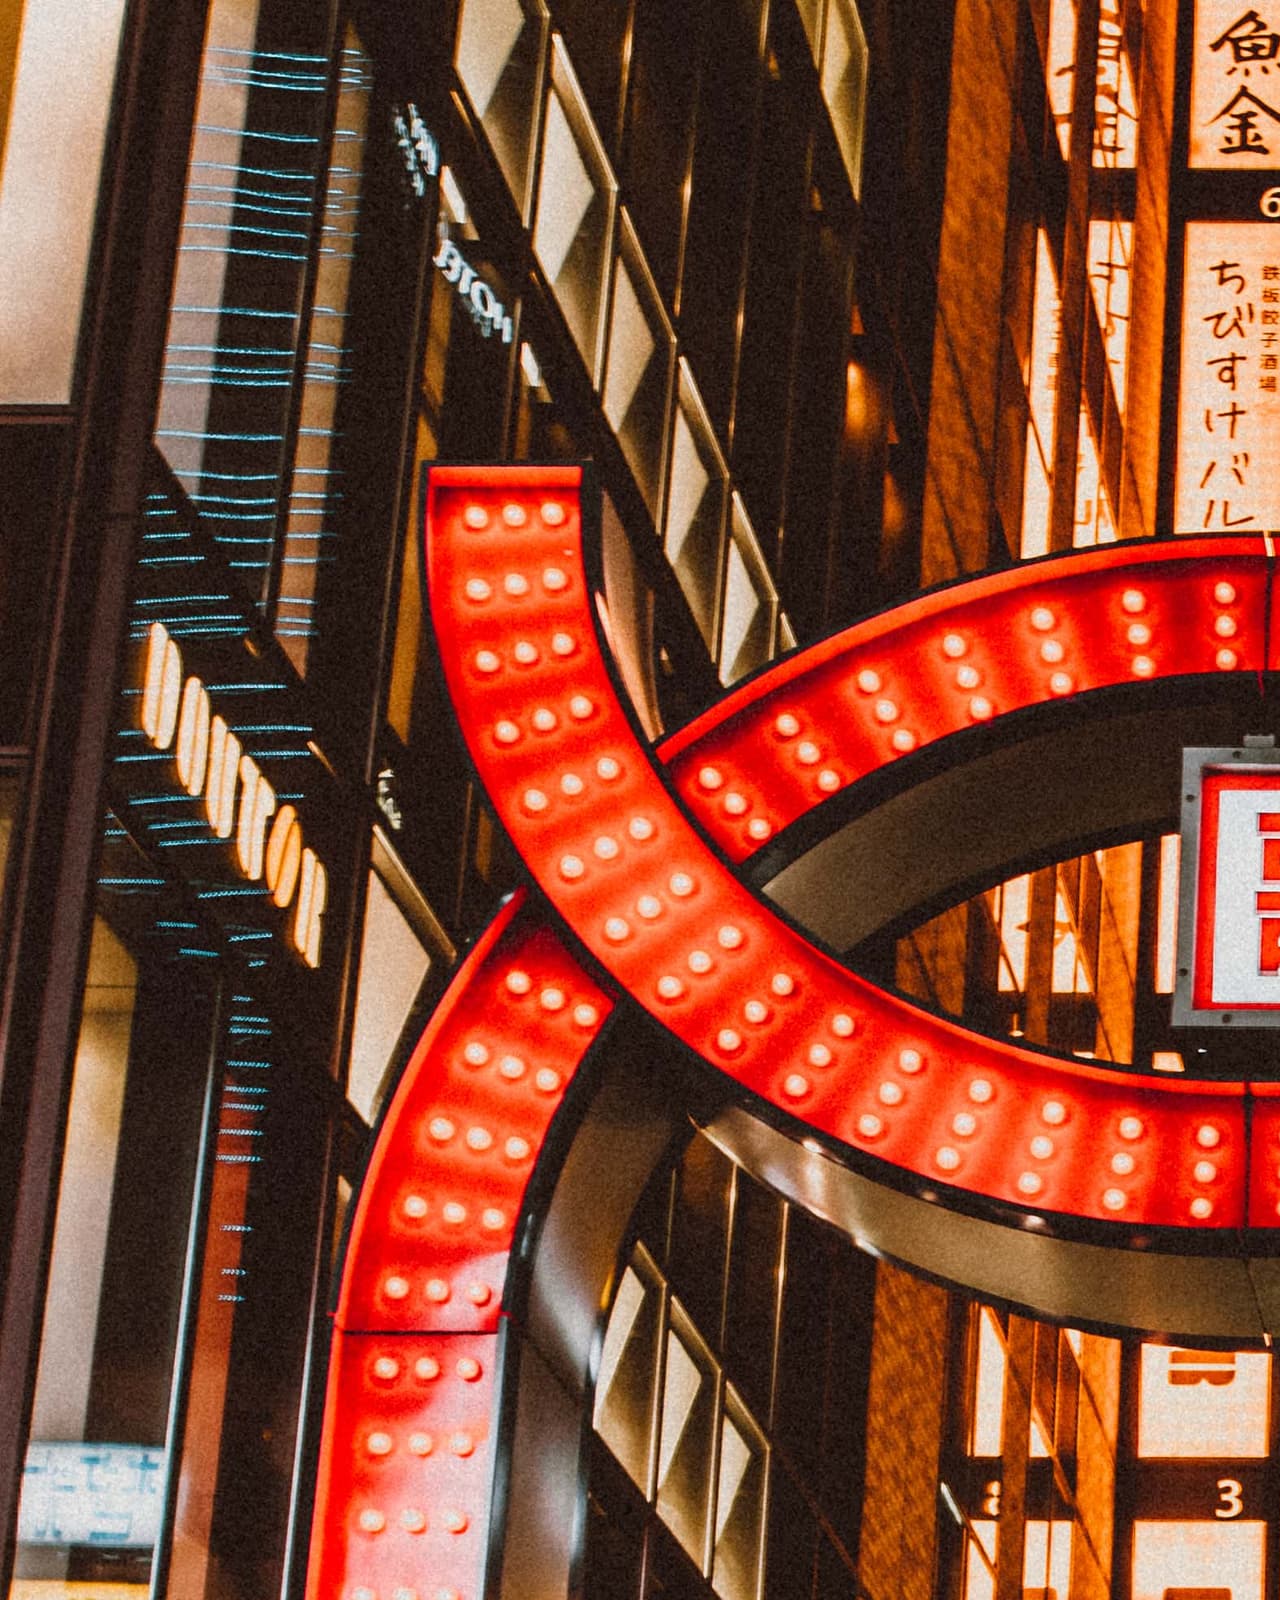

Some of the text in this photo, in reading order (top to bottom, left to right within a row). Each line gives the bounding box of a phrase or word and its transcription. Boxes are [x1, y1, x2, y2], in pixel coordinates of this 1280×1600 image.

[1200, 258, 1256, 530] ちびすけバル
[1214, 1479, 1244, 1519] 3
